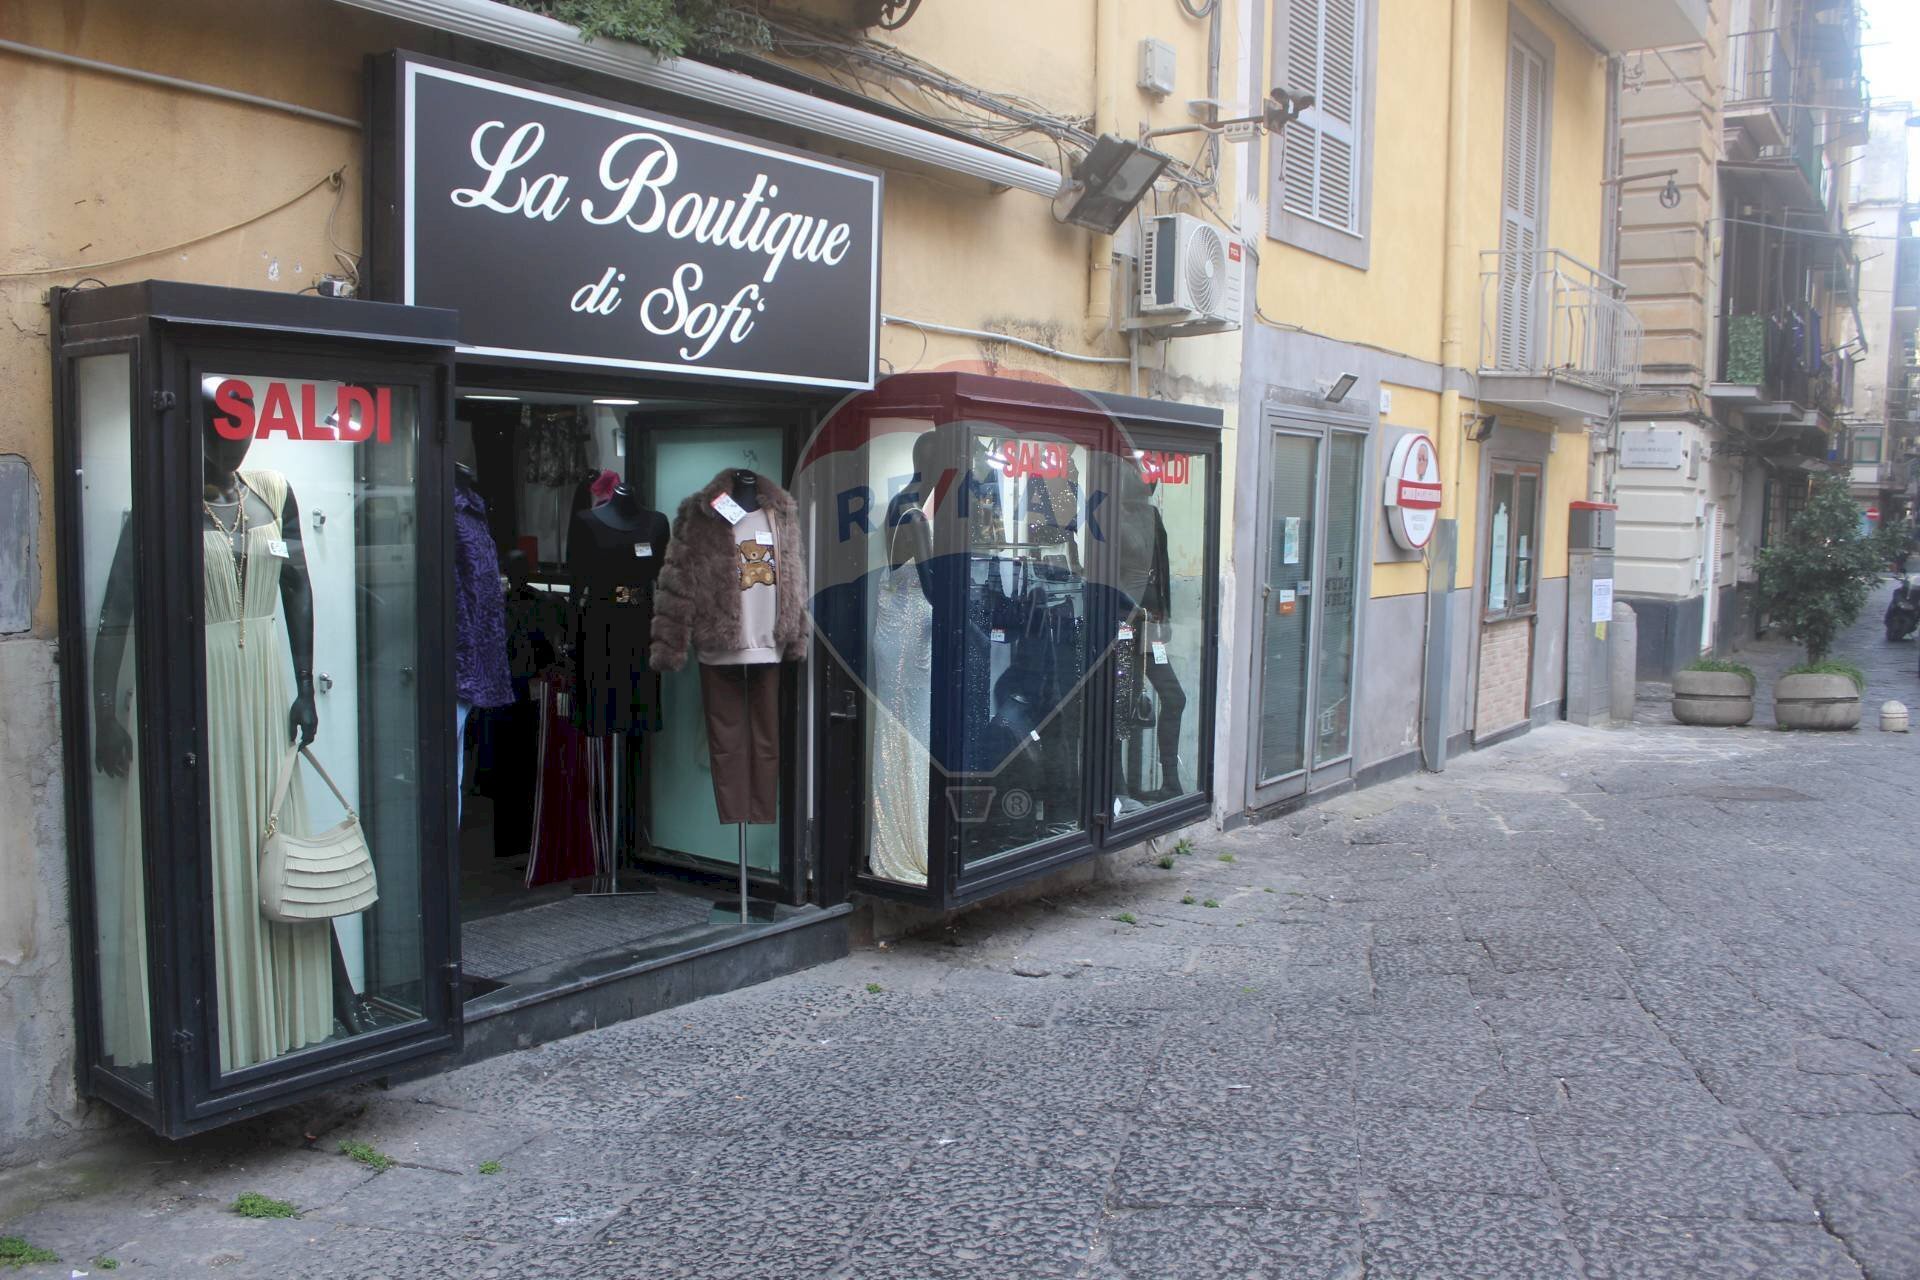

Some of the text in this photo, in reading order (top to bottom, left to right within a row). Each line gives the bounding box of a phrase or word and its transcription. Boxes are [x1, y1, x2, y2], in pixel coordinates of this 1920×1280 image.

[450, 120, 851, 284] La Boutique
[570, 266, 626, 316] di
[212, 378, 393, 444] SALDI
[1002, 440, 1069, 480] SALDI
[1141, 452, 1190, 485] SALDI
